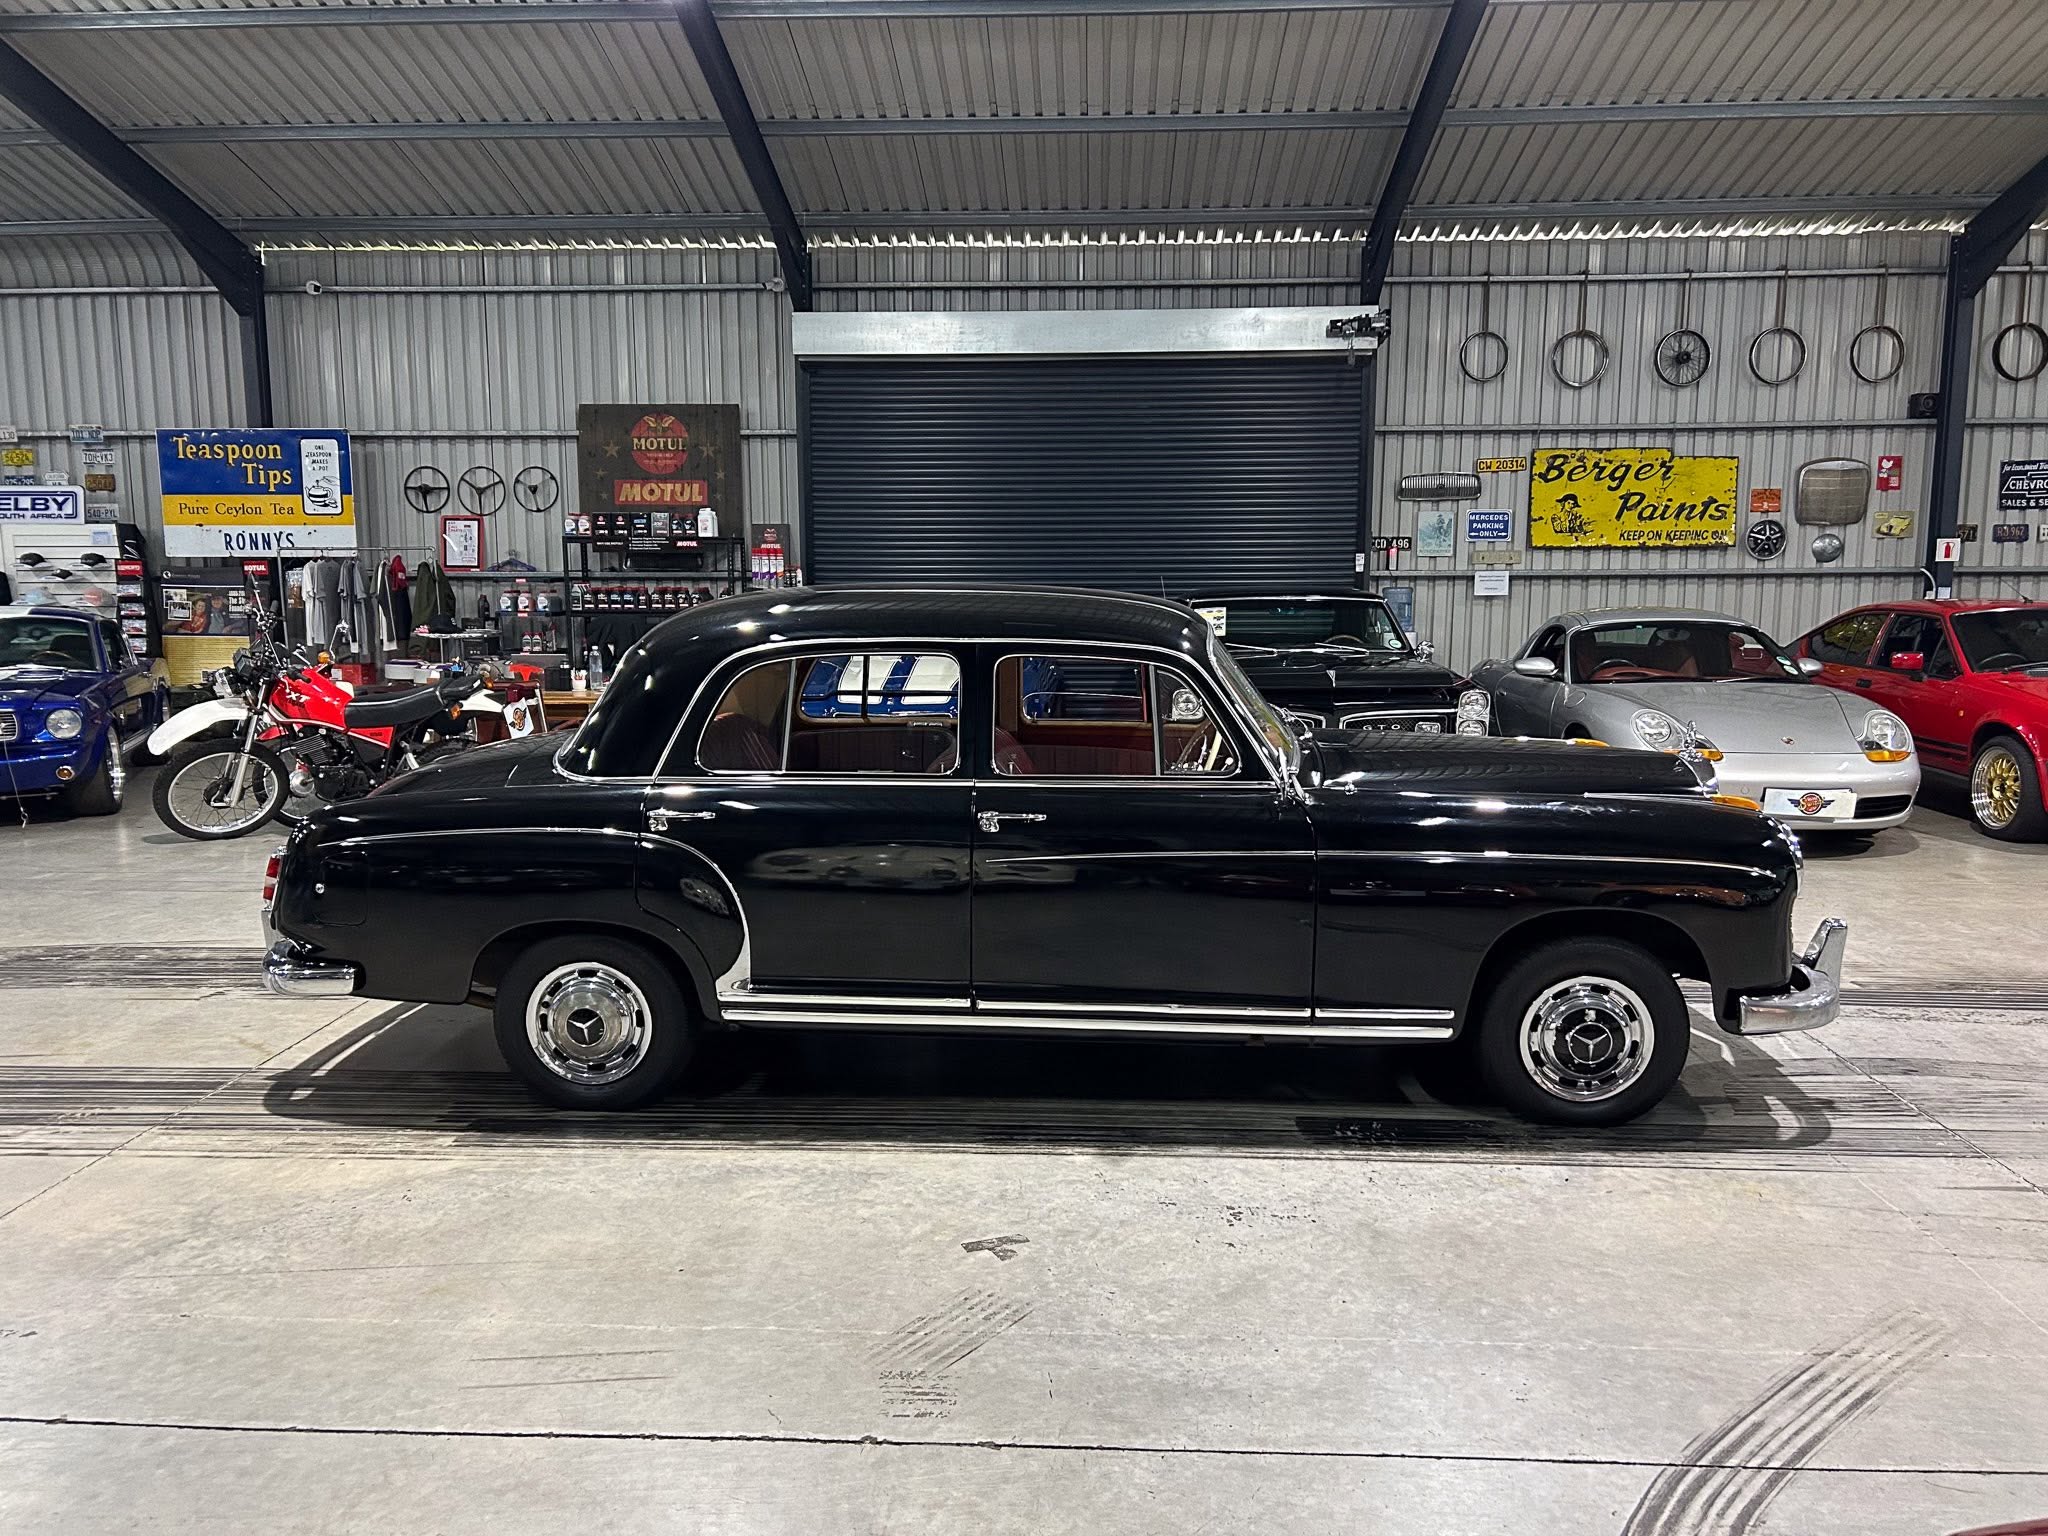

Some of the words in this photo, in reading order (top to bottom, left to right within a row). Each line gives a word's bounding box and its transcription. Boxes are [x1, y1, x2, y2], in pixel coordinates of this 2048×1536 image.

[633, 437, 686, 450] MOTUL
[173, 437, 282, 466] Teaspoon
[1478, 460, 1492, 470] CW
[1496, 459, 1525, 470] 20314
[2002, 464, 2012, 474] for
[241, 462, 292, 491] Tips
[1537, 453, 1675, 492] Berger
[619, 483, 703, 502] MOTUL
[0, 497, 70, 511] ELBY
[178, 503, 209, 515] Pure
[215, 503, 262, 517] Ceylon
[270, 504, 294, 515] Tea
[1614, 491, 1731, 522] Paints
[224, 532, 295, 550] RONNYS
[1619, 530, 1645, 541] KEEP
[1646, 530, 1662, 541] ON
[1665, 529, 1709, 541] KEEPING
[1392, 538, 1410, 548] 496
[285, 690, 311, 703] XT
